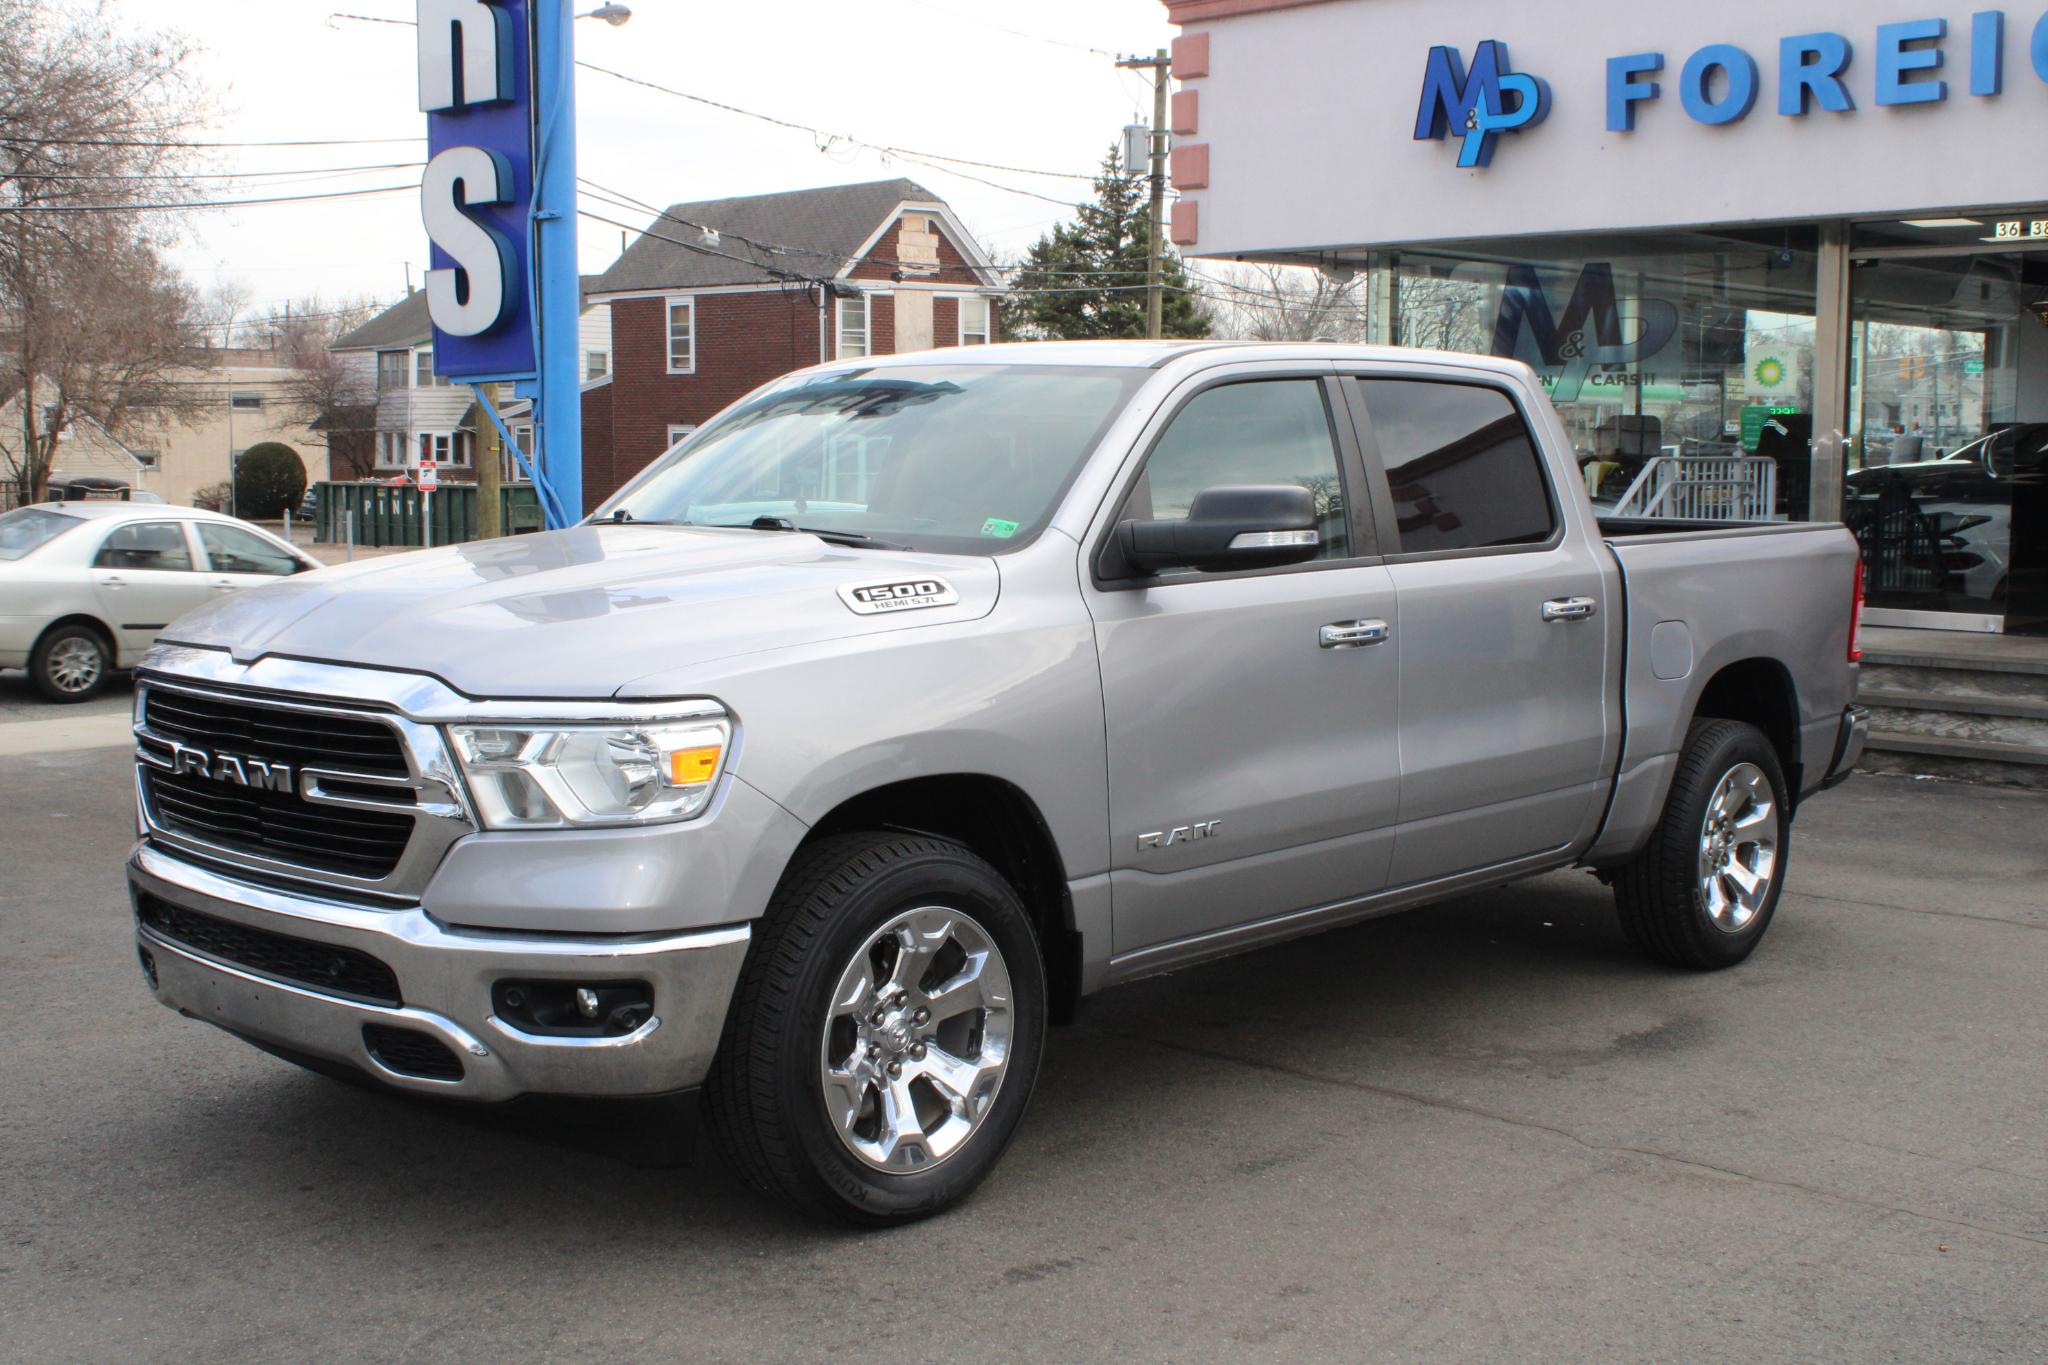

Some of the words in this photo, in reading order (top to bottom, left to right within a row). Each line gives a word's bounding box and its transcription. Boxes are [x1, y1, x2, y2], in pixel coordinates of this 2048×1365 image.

[1606, 9, 2048, 132] FOREI
[1591, 374, 1639, 387] CARS
[854, 581, 938, 602] 1500
[874, 600, 909, 609] HEMI
[912, 596, 940, 606] 5.7L
[174, 746, 293, 794] RAM
[1136, 819, 1222, 852] RAM
